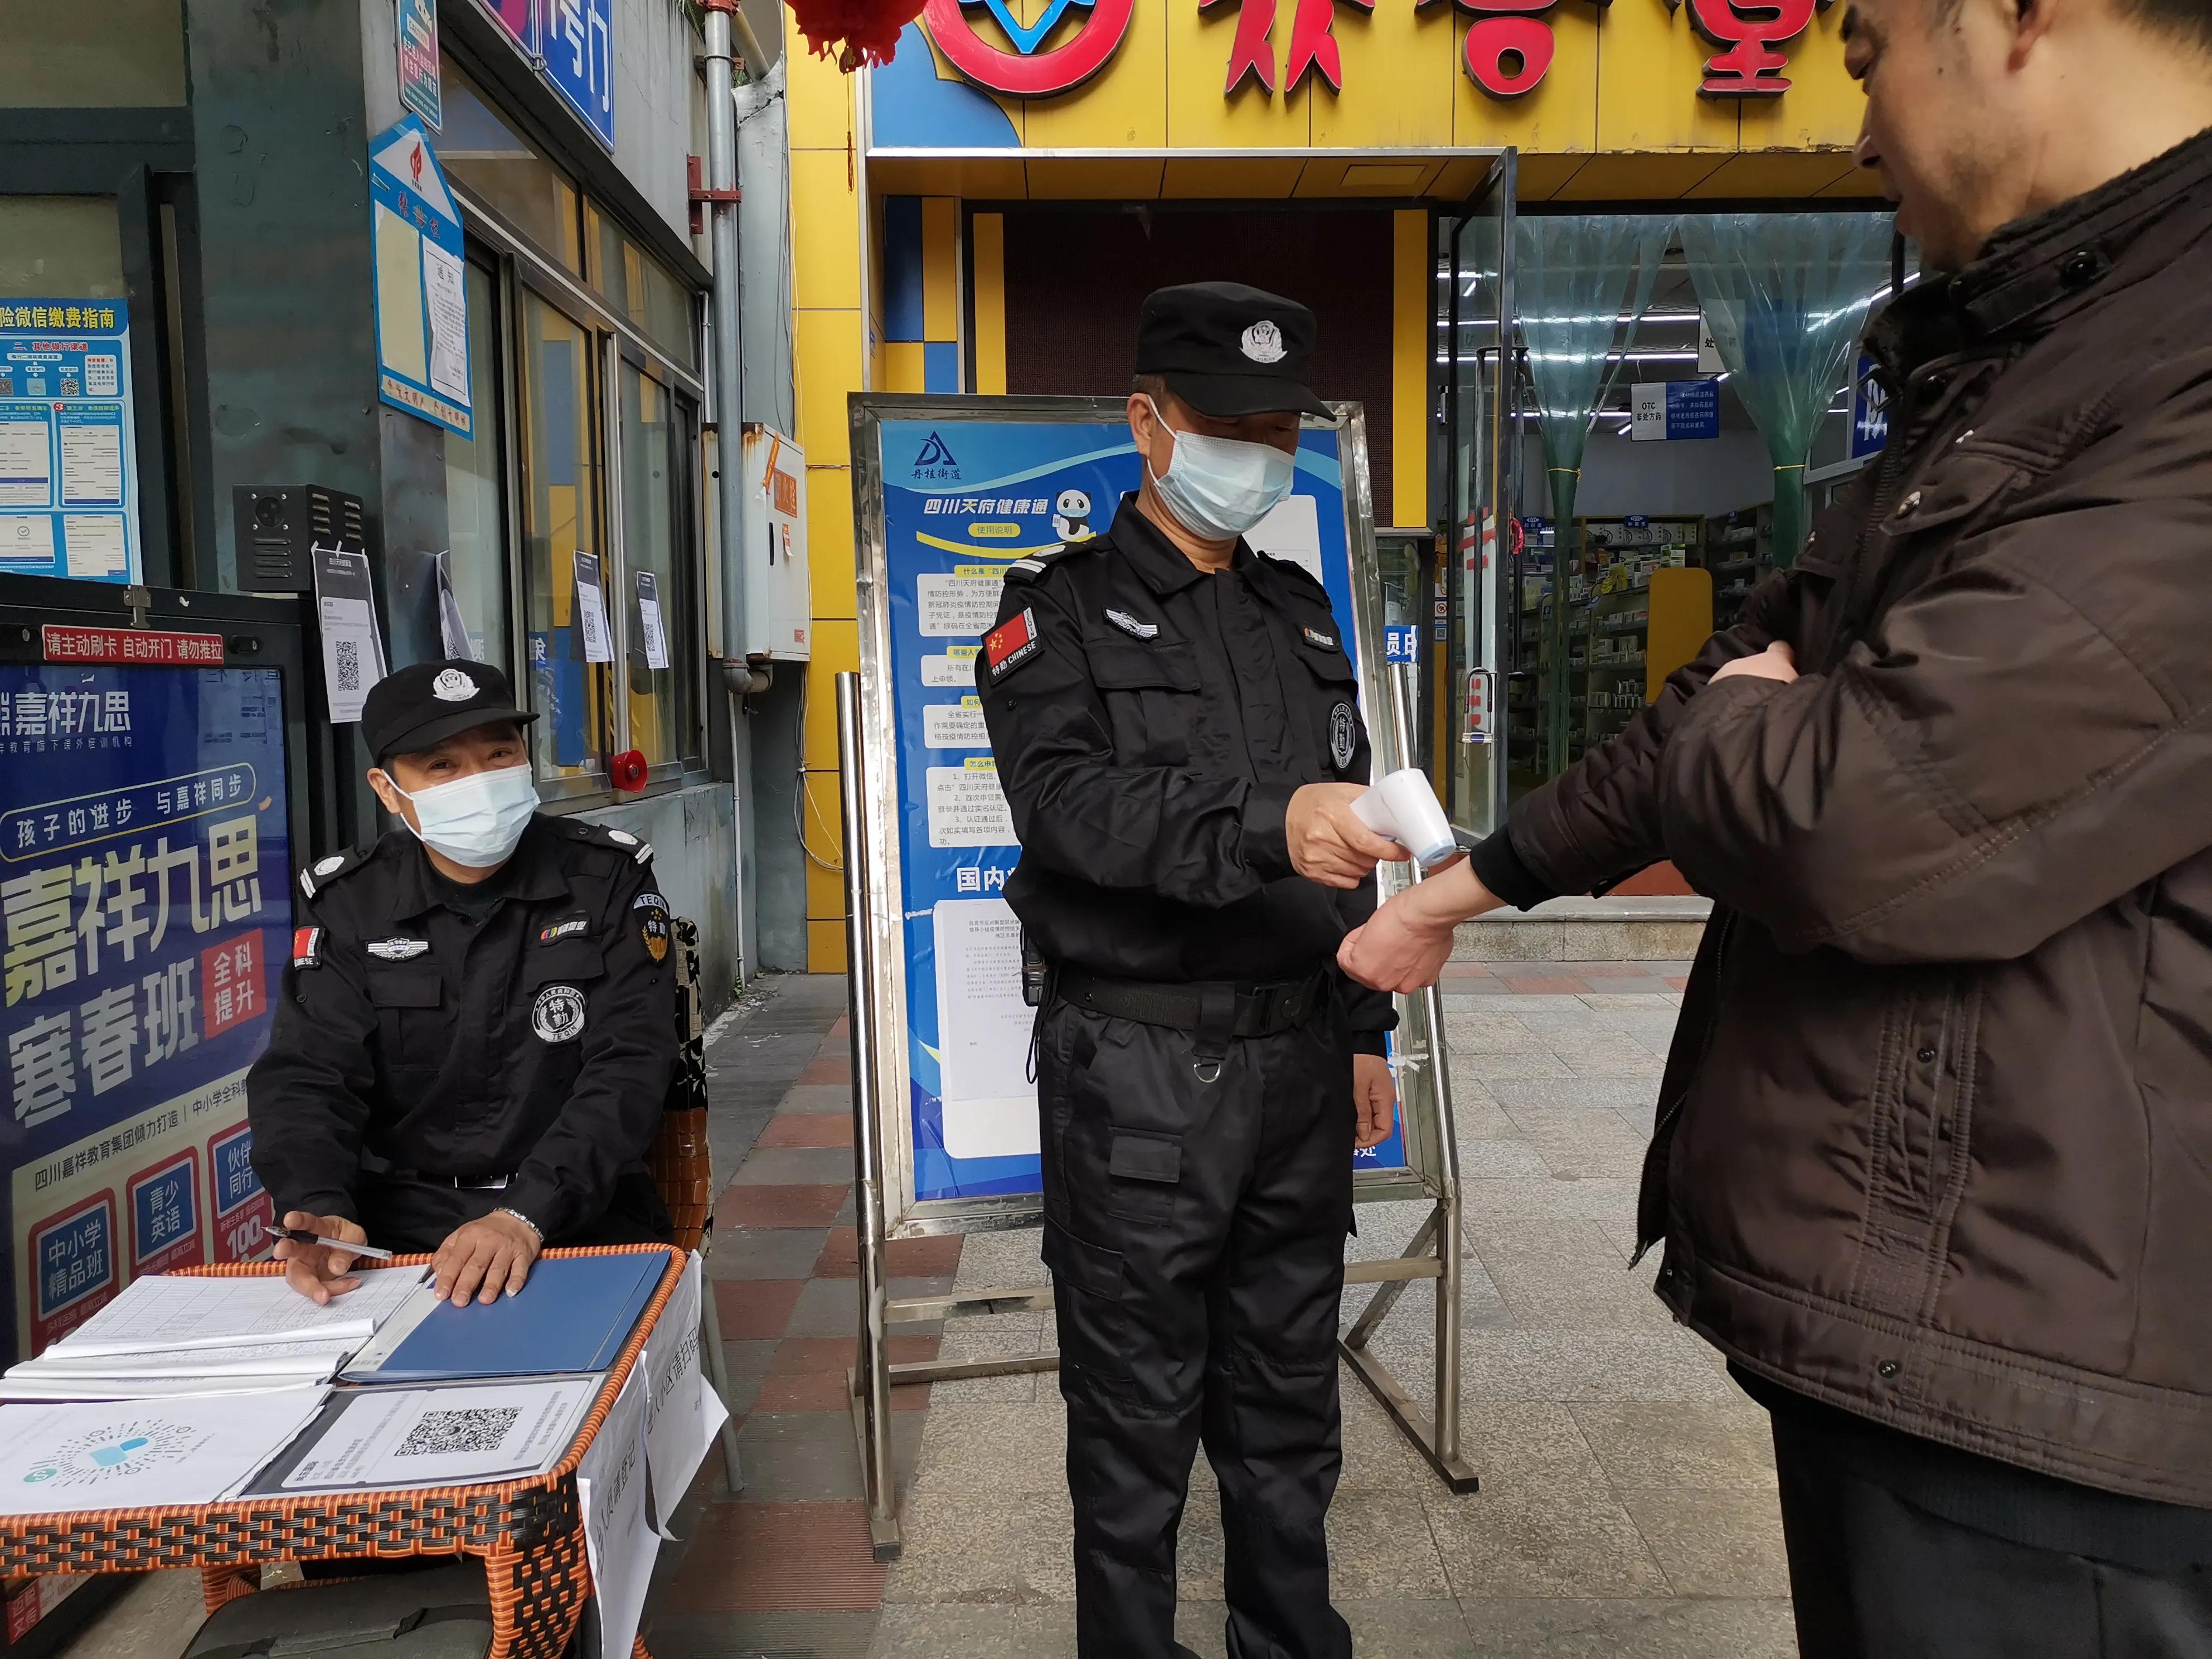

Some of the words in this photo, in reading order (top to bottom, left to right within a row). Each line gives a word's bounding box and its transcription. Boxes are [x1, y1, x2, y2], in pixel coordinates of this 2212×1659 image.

[0, 307, 115, 329] 险微信缴费指南
[1636, 413, 1662, 422] 非处方药
[1642, 402, 1656, 410] OTC
[910, 468, 962, 481] 丹桂街道
[923, 498, 1049, 515] 四川天府健康通
[977, 526, 1013, 535] 使用说明
[46, 633, 117, 657] 请主动刷卡
[123, 637, 172, 659] 自动开门
[177, 641, 222, 660] 请勿推拉
[1008, 641, 1036, 664] CHINESE
[15, 691, 132, 736] 嘉祥九思
[17, 798, 133, 848] 孩子的进步
[157, 773, 242, 814] 与嘉祥同步
[1, 814, 262, 1007] 嘉祥九思
[214, 942, 253, 988] 全科
[214, 980, 254, 1025] 提升
[549, 998, 569, 1027] 特勤
[35, 1109, 180, 1192] 四川嘉祥教育集团倾力打造
[227, 1140, 251, 1167] 伙伴
[150, 1179, 180, 1214] 青少
[229, 1169, 253, 1199] 同行
[48, 1218, 101, 1268] 中小学
[150, 1210, 181, 1244] 英语
[226, 1214, 264, 1260] 100
[48, 1249, 104, 1300] 精品班
